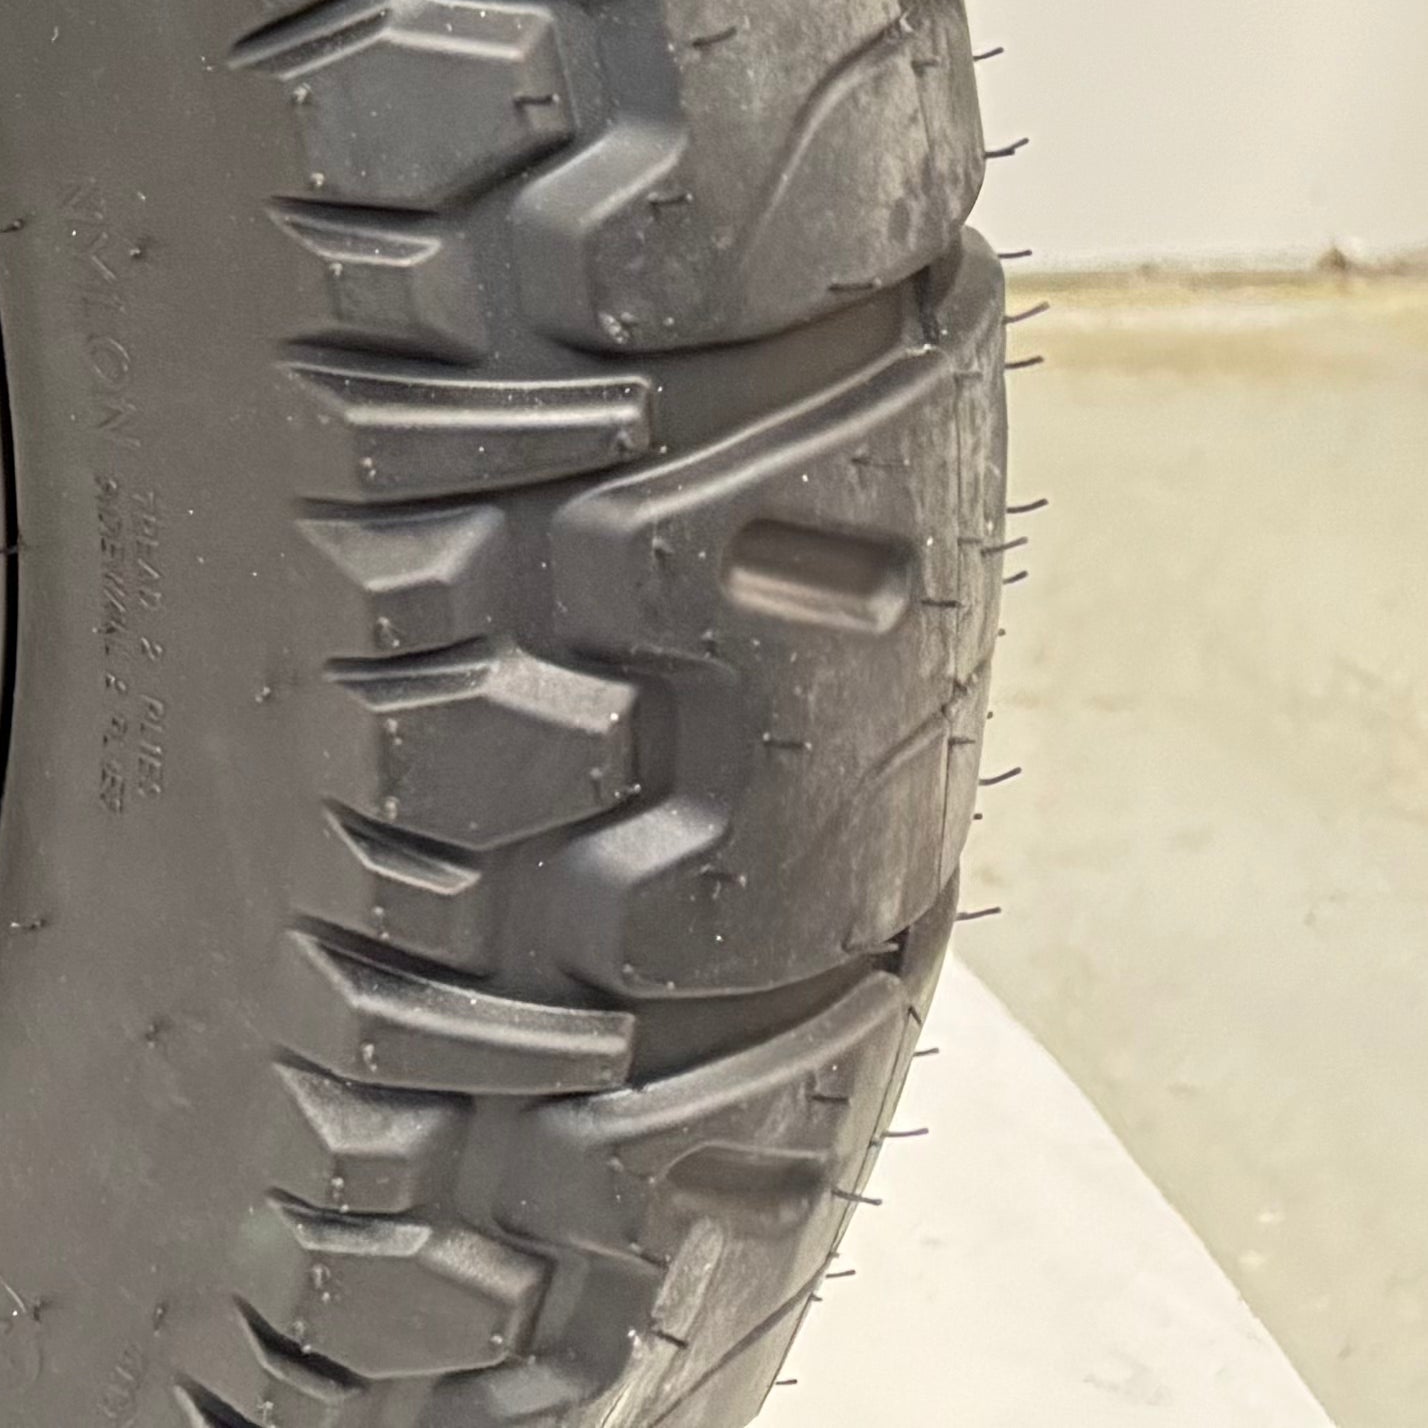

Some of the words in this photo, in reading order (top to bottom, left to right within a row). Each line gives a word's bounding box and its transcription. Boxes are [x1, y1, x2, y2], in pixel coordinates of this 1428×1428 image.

[58, 177, 139, 448] NYLON
[92, 472, 131, 656] SIDEWALL
[130, 490, 164, 613] TREAD
[139, 635, 166, 663] 2
[136, 694, 166, 798] PLIES
